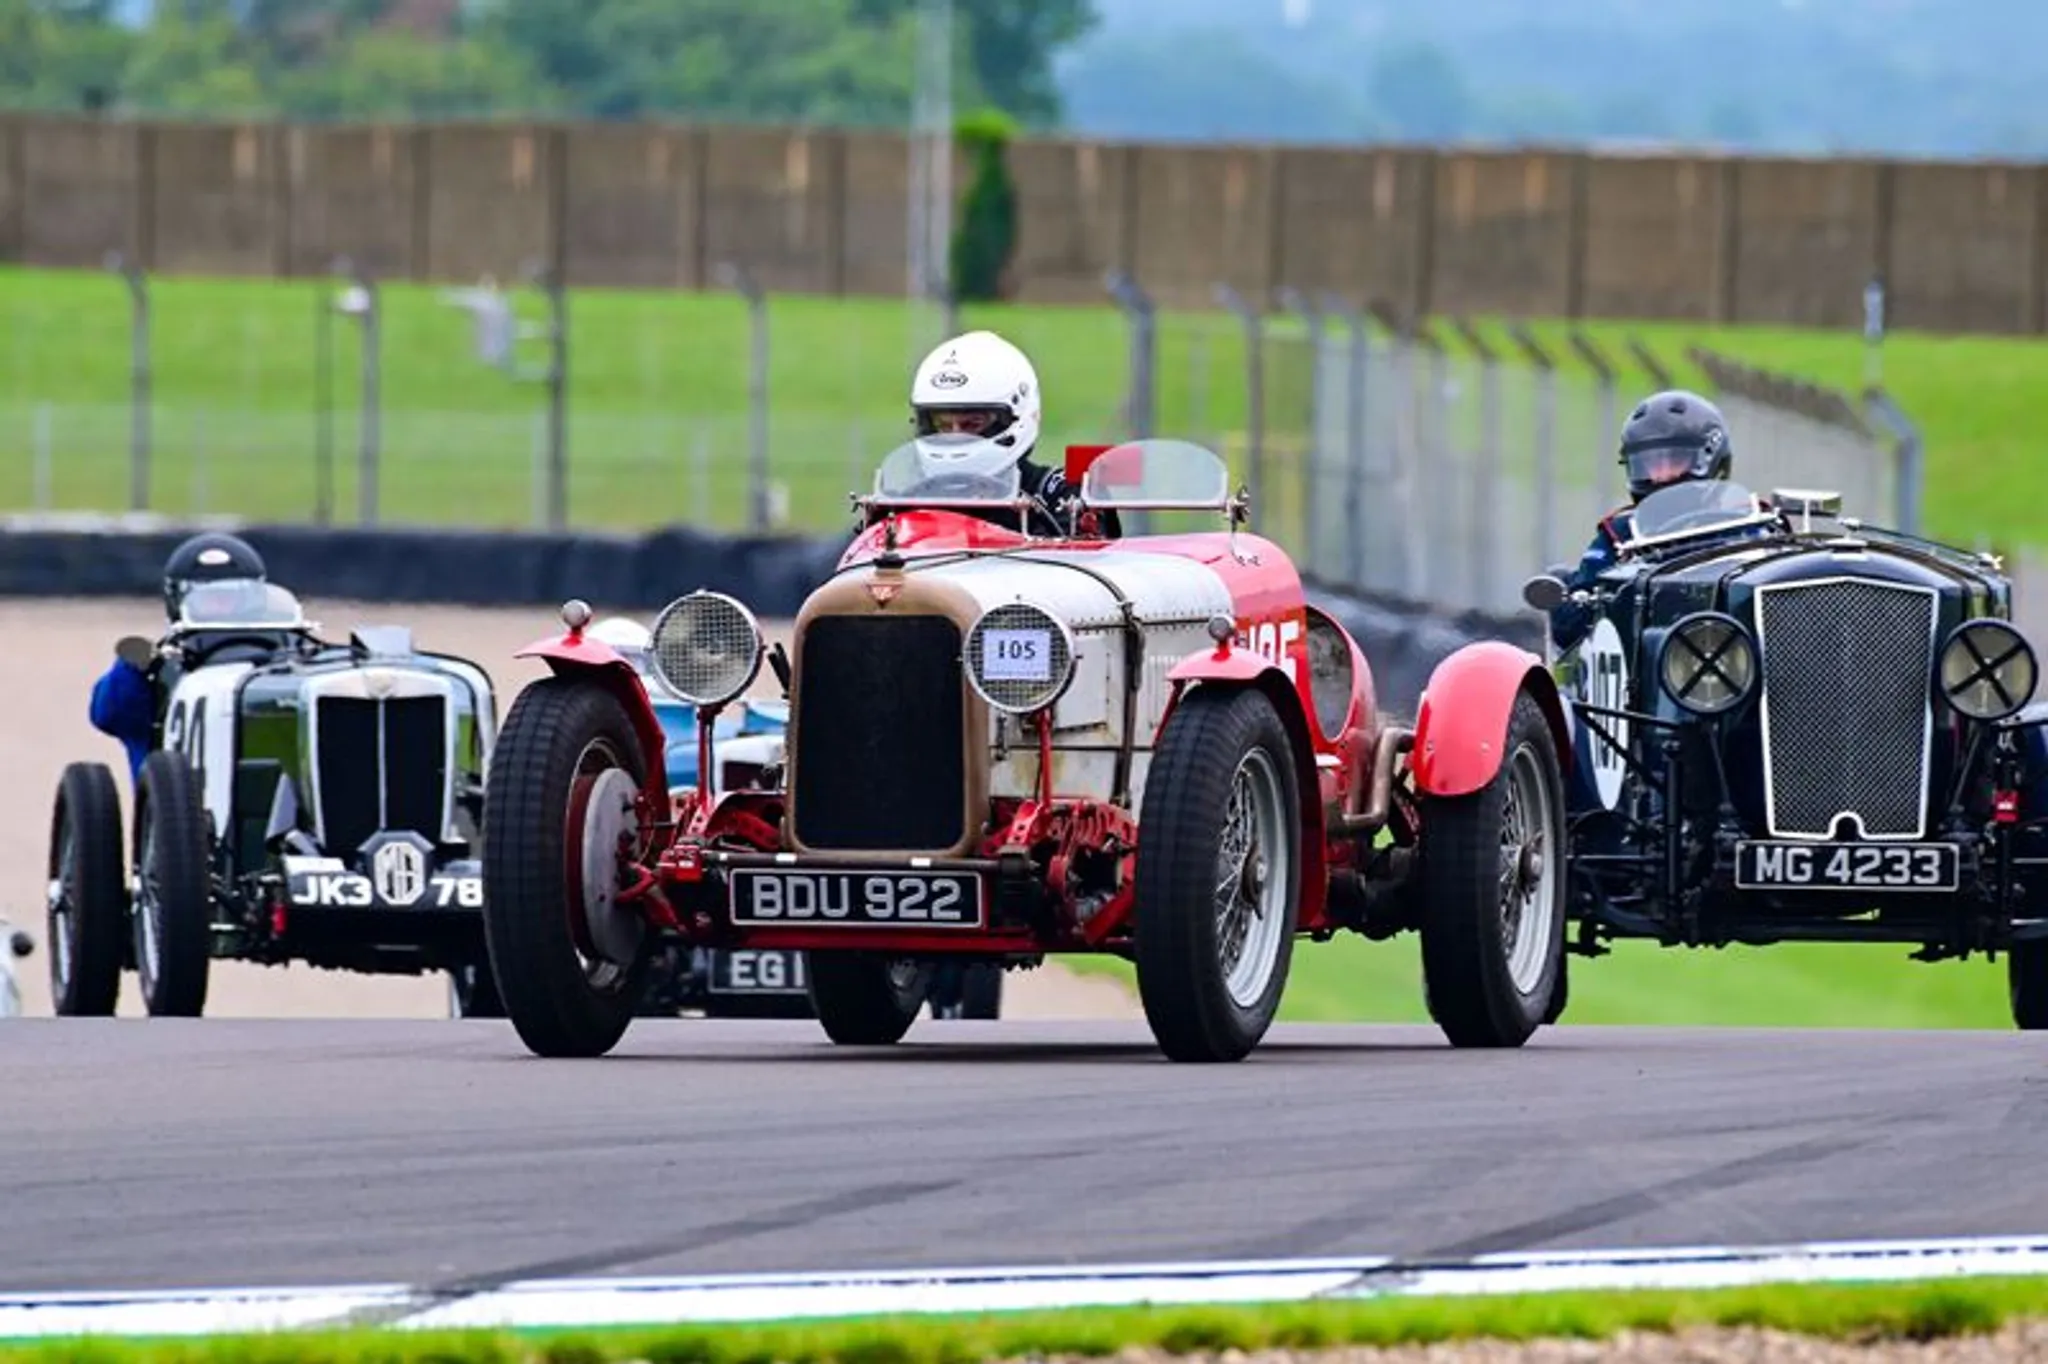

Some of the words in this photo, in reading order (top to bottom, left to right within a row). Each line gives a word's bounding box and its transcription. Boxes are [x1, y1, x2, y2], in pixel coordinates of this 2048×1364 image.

[998, 640, 1036, 660] 105
[1756, 846, 1813, 882] MG
[1825, 848, 1941, 884] 4233
[292, 876, 373, 905] JK3
[430, 877, 483, 907] 78
[752, 875, 849, 918] BDU
[864, 877, 962, 920] 922
